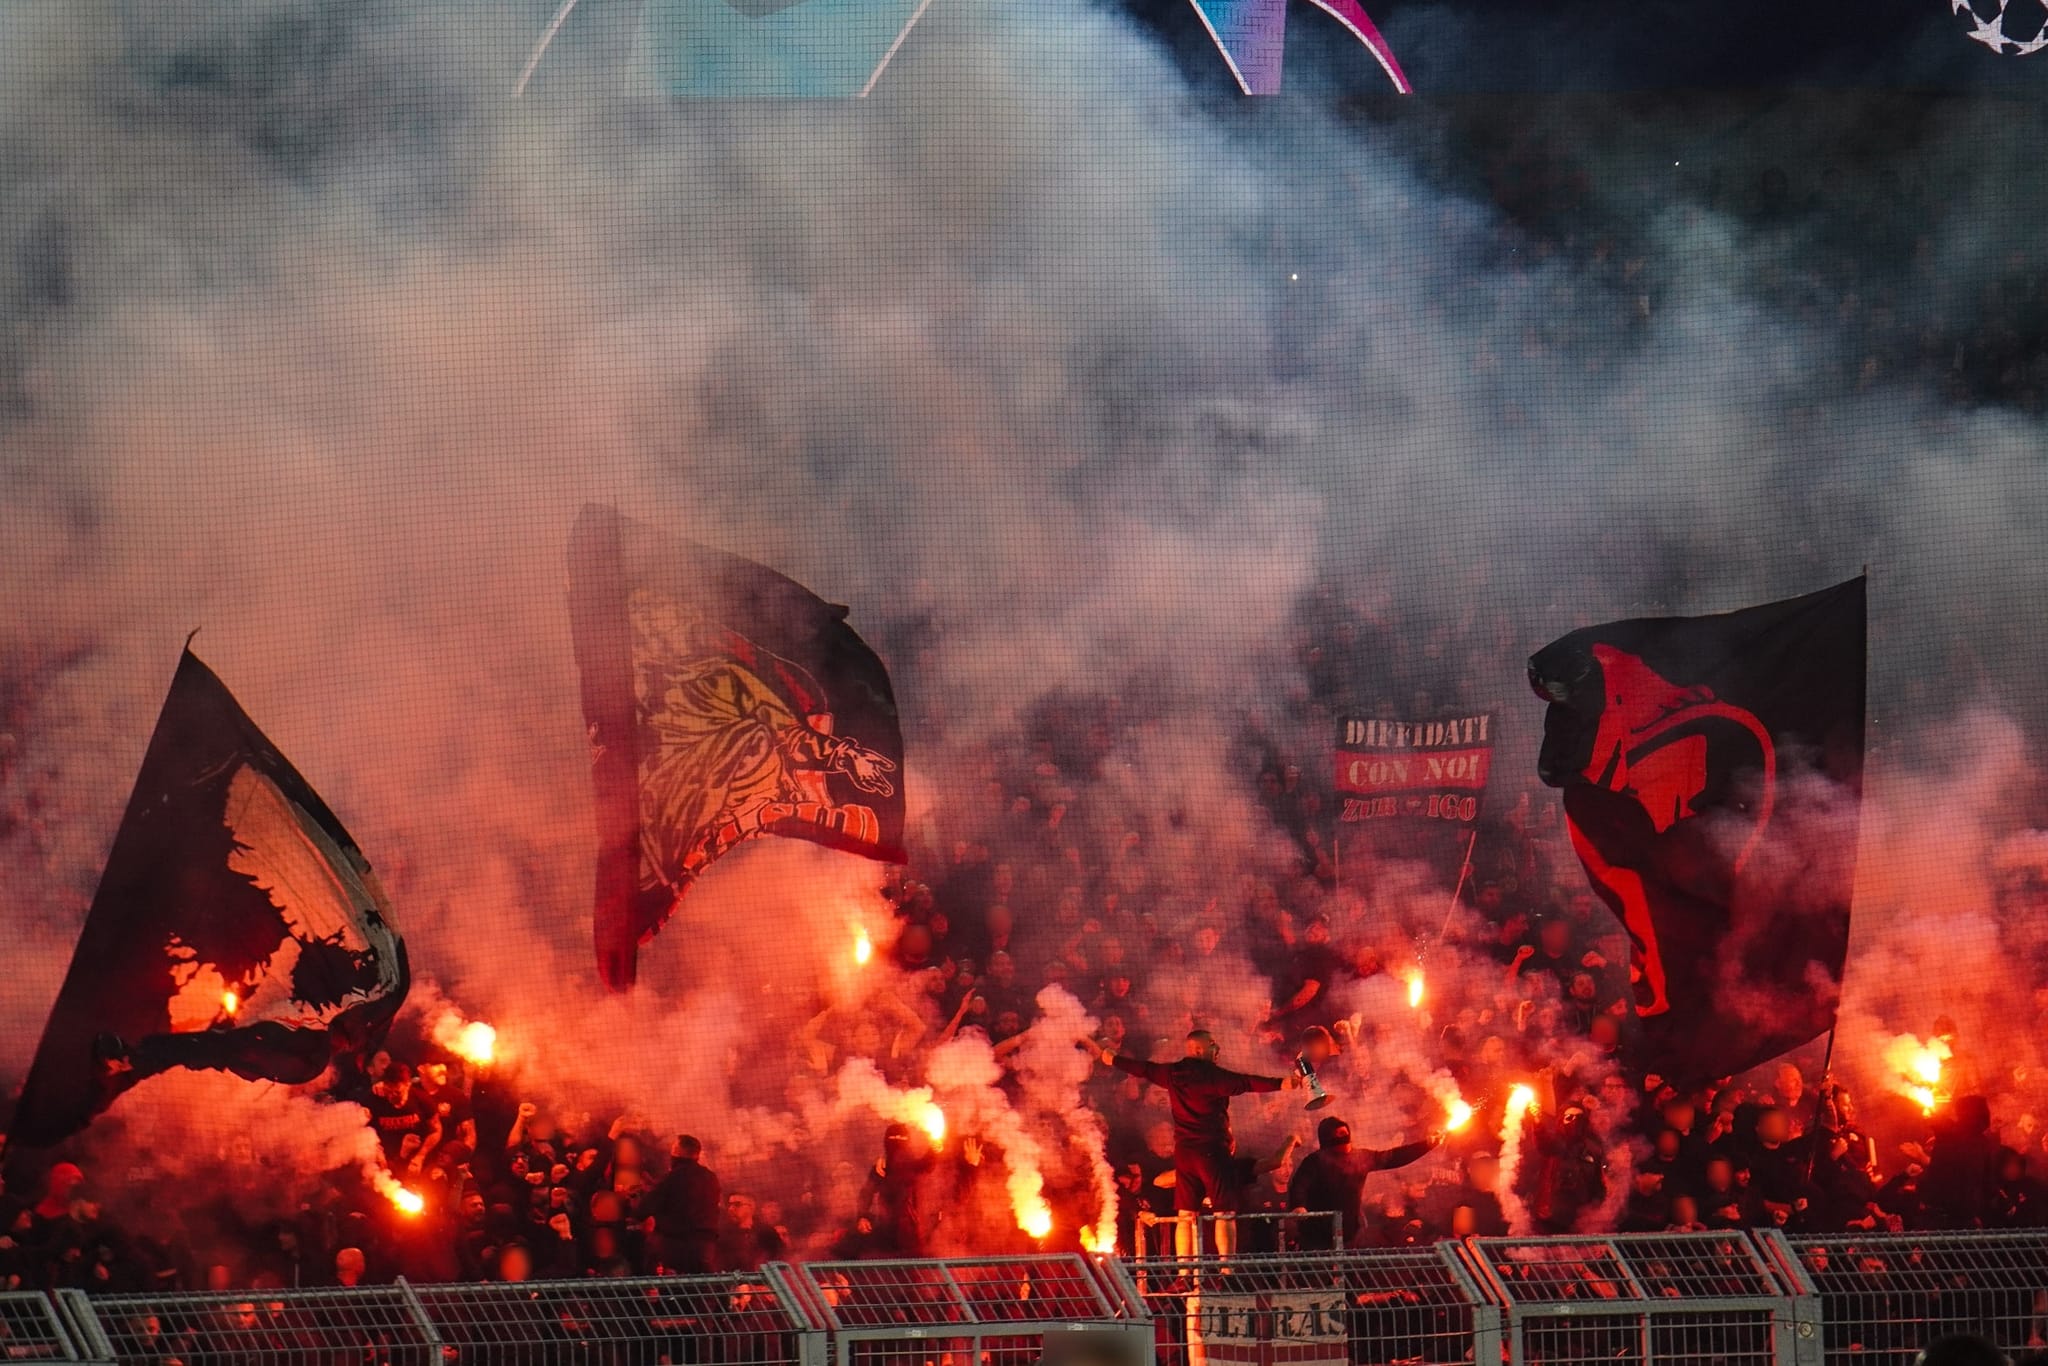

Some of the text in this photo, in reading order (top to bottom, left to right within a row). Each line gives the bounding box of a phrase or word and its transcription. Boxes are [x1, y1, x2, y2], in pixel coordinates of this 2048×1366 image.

[1346, 715, 1489, 747] DIFFIDATI
[1349, 755, 1480, 786] CON NOI
[1427, 794, 1477, 822] IGO
